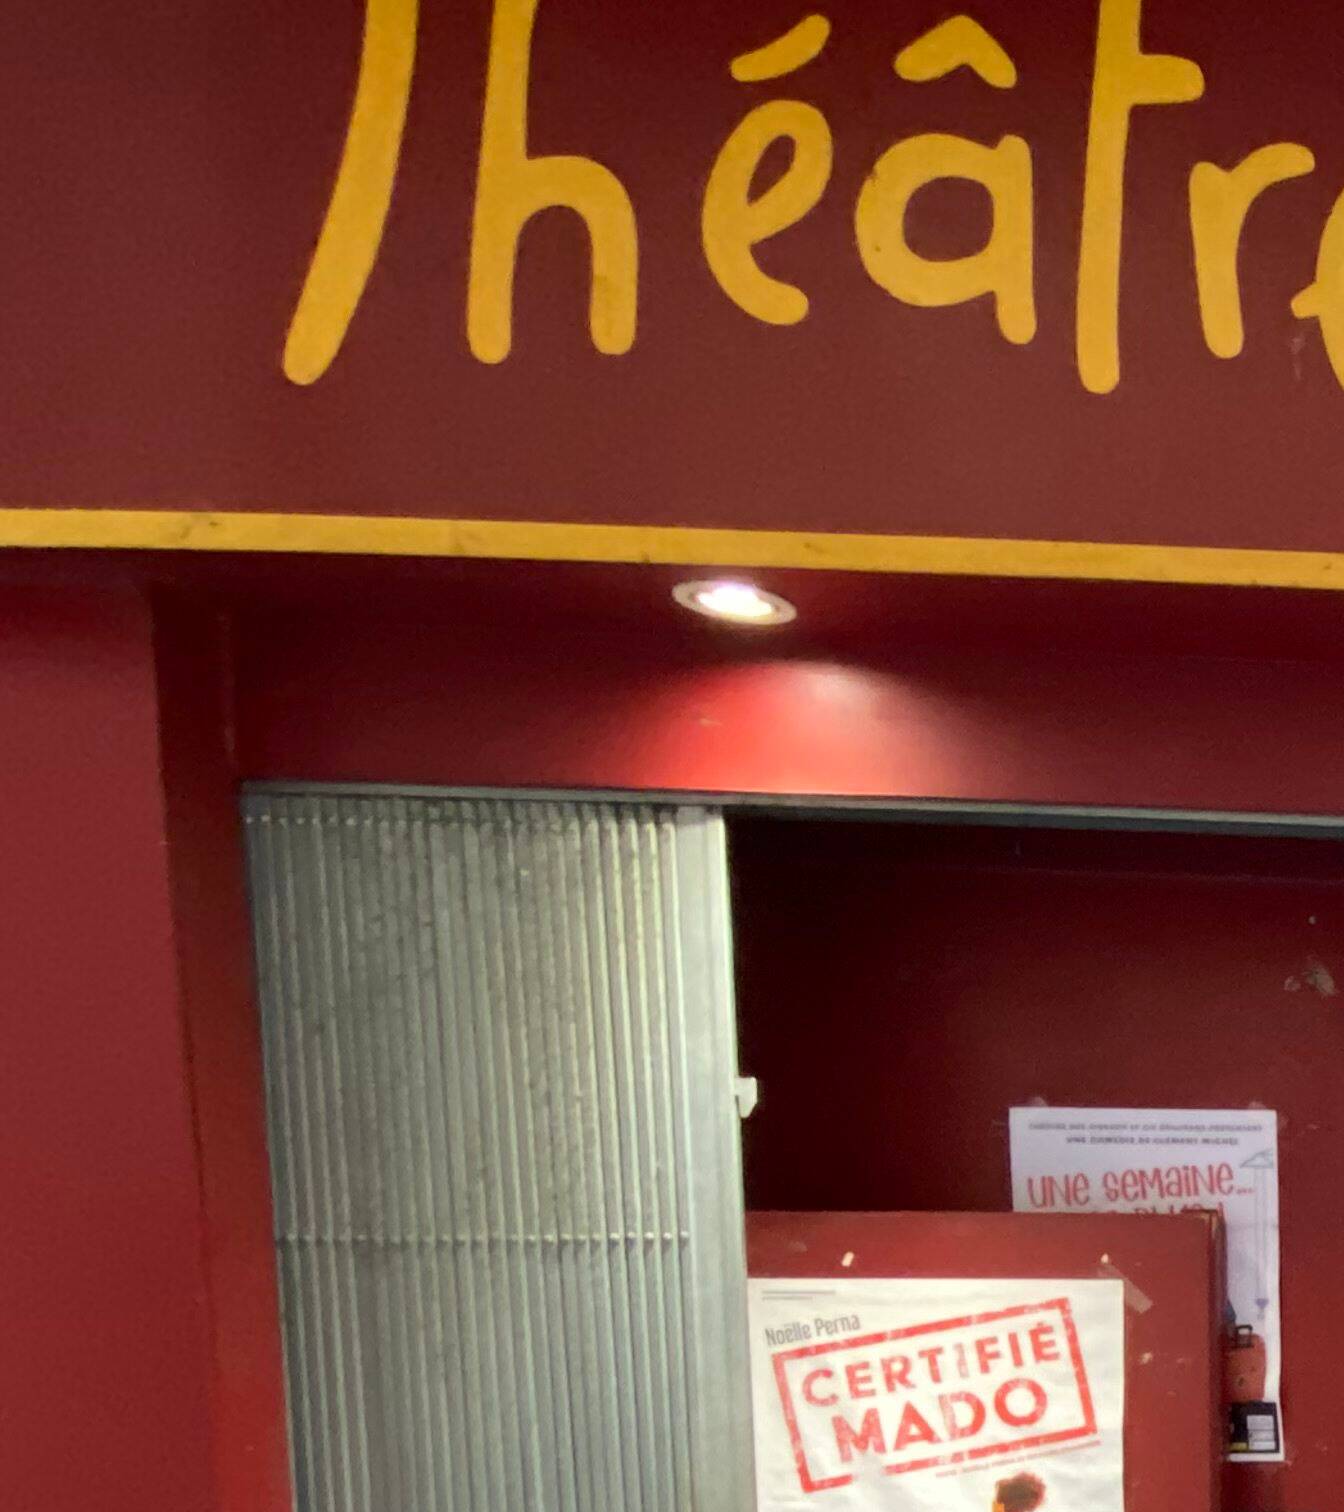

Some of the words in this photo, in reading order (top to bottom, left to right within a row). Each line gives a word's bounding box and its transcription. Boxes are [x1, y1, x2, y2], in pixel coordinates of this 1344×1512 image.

[765, 1317, 812, 1347] Noëlle
[813, 1313, 861, 1340] Perna
[801, 1320, 1063, 1408] CERTIFIÉ
[831, 1378, 1049, 1464] MADO
